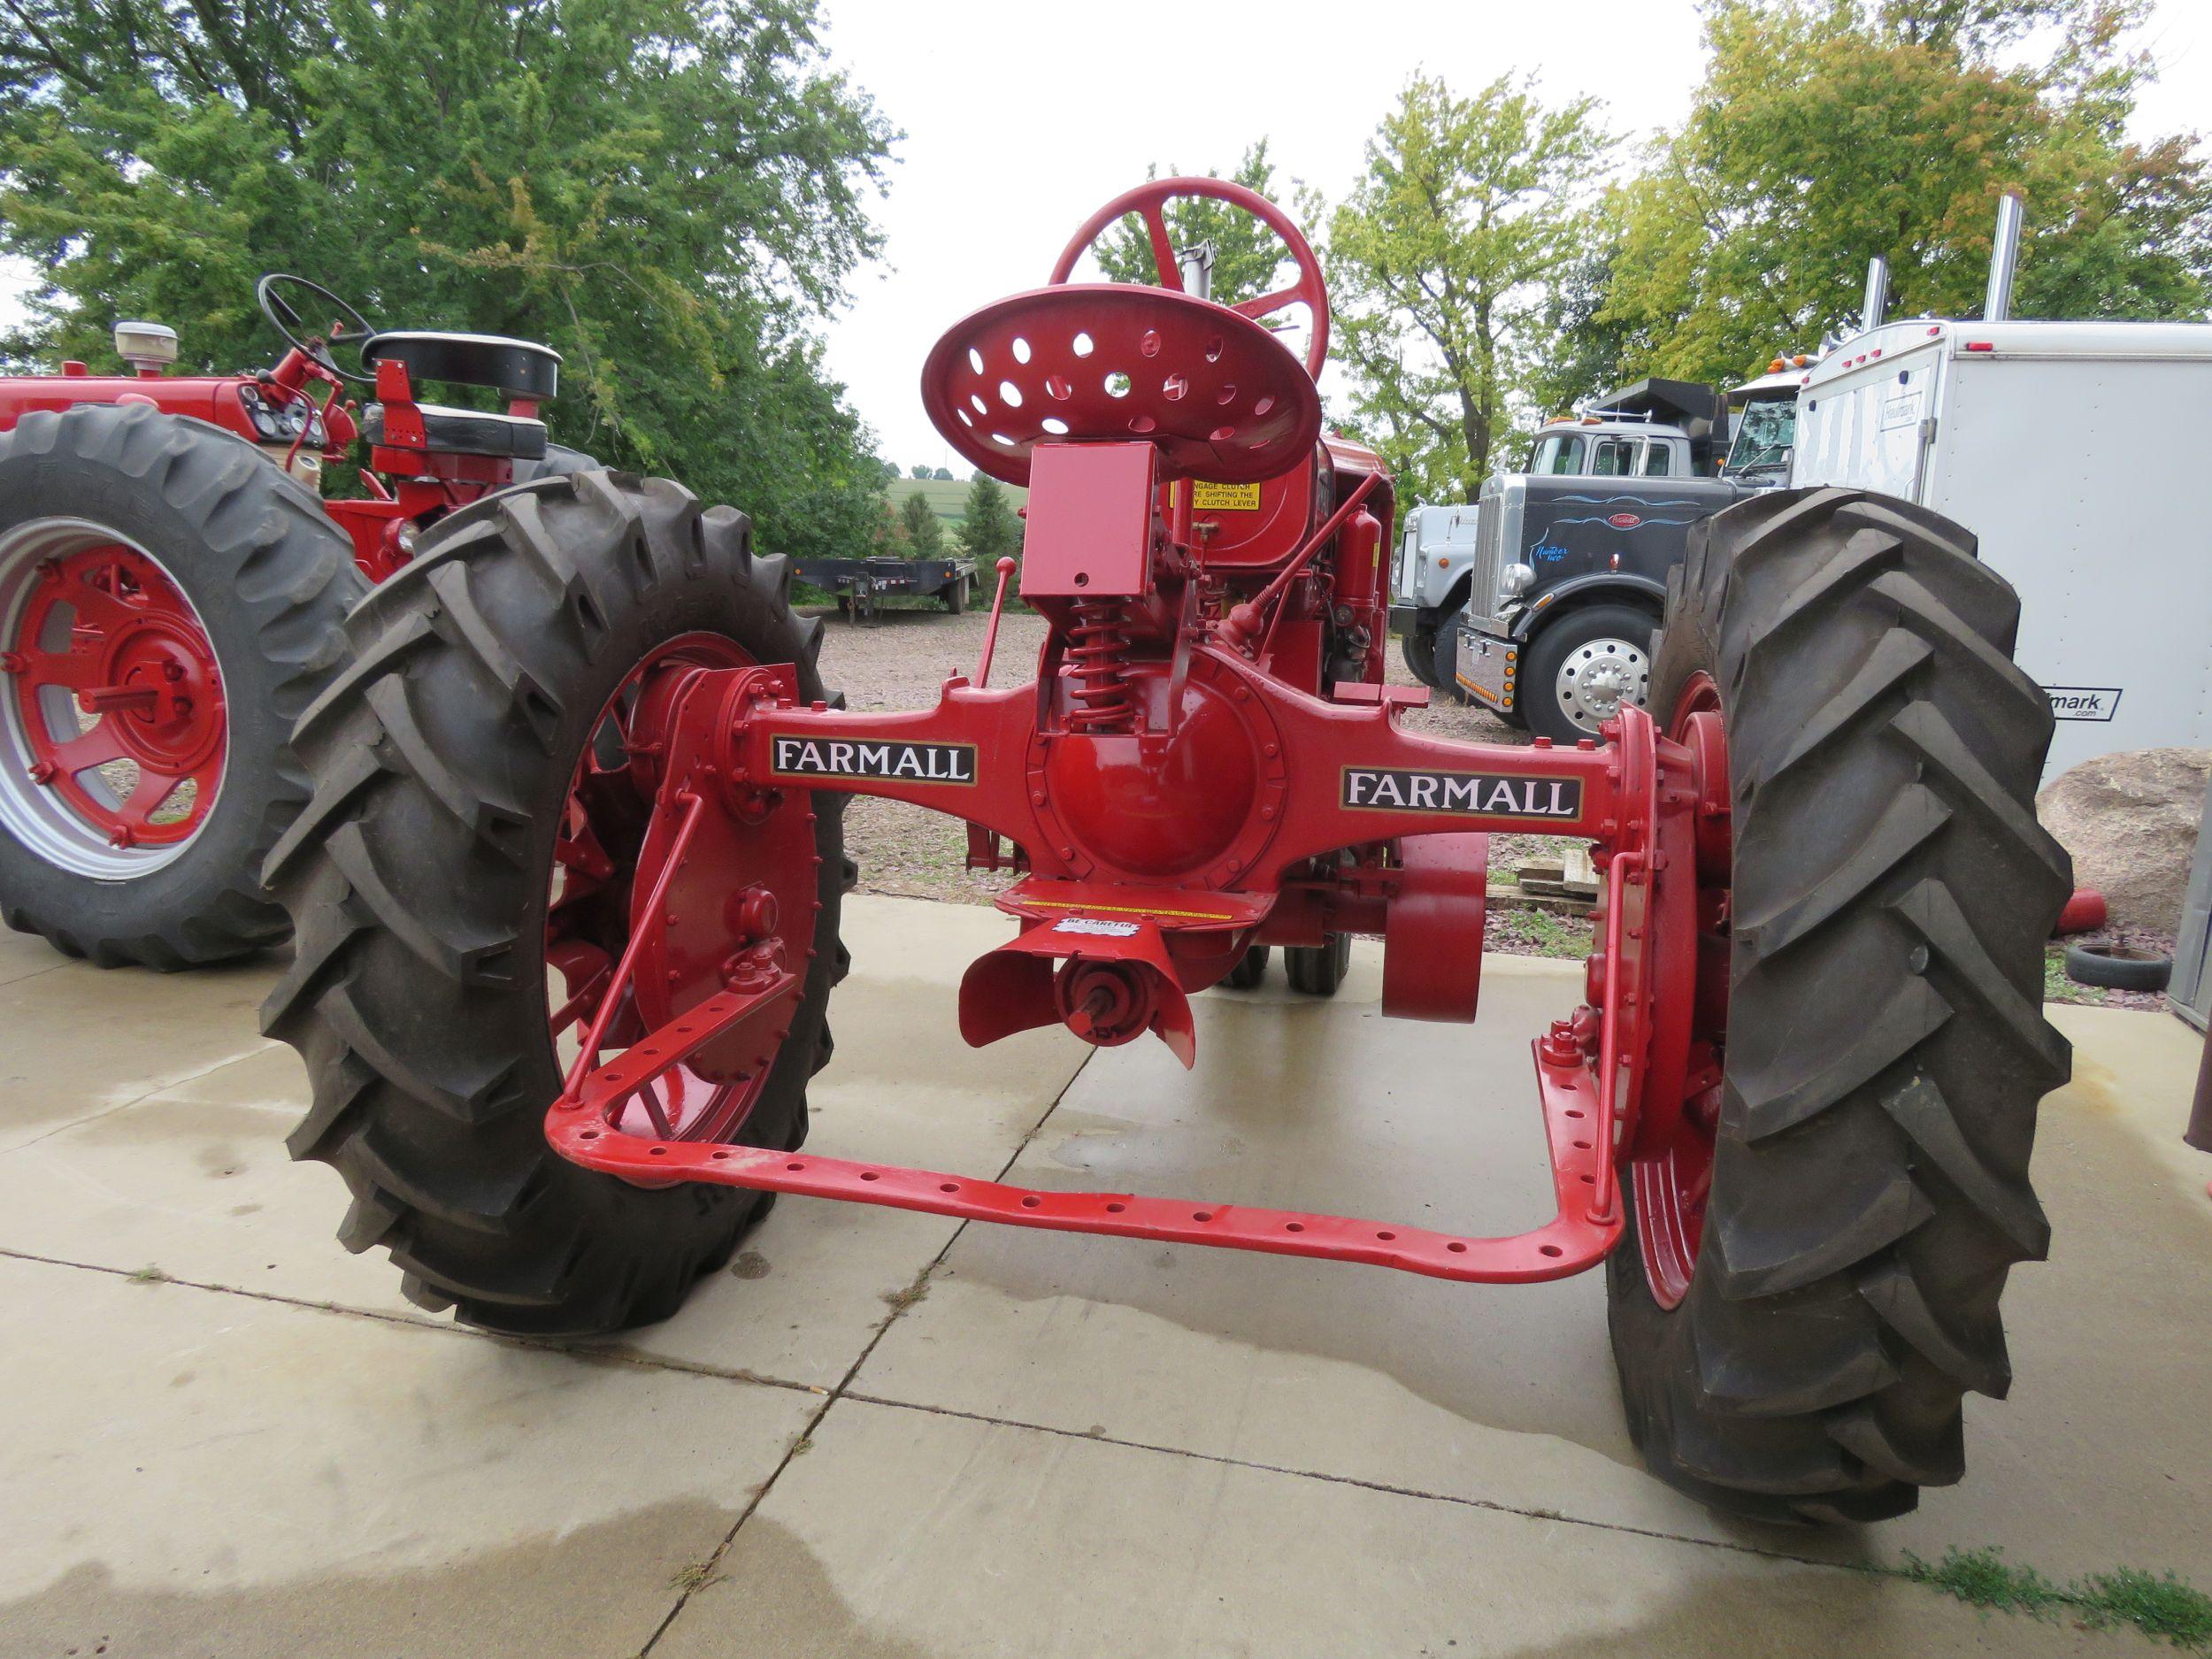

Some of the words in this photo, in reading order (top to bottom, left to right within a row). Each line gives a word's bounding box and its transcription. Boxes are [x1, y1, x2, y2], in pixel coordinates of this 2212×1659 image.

[2048, 694, 2101, 710] mark
[777, 740, 971, 780] FARMALL
[1348, 772, 1575, 815] FARMALL
